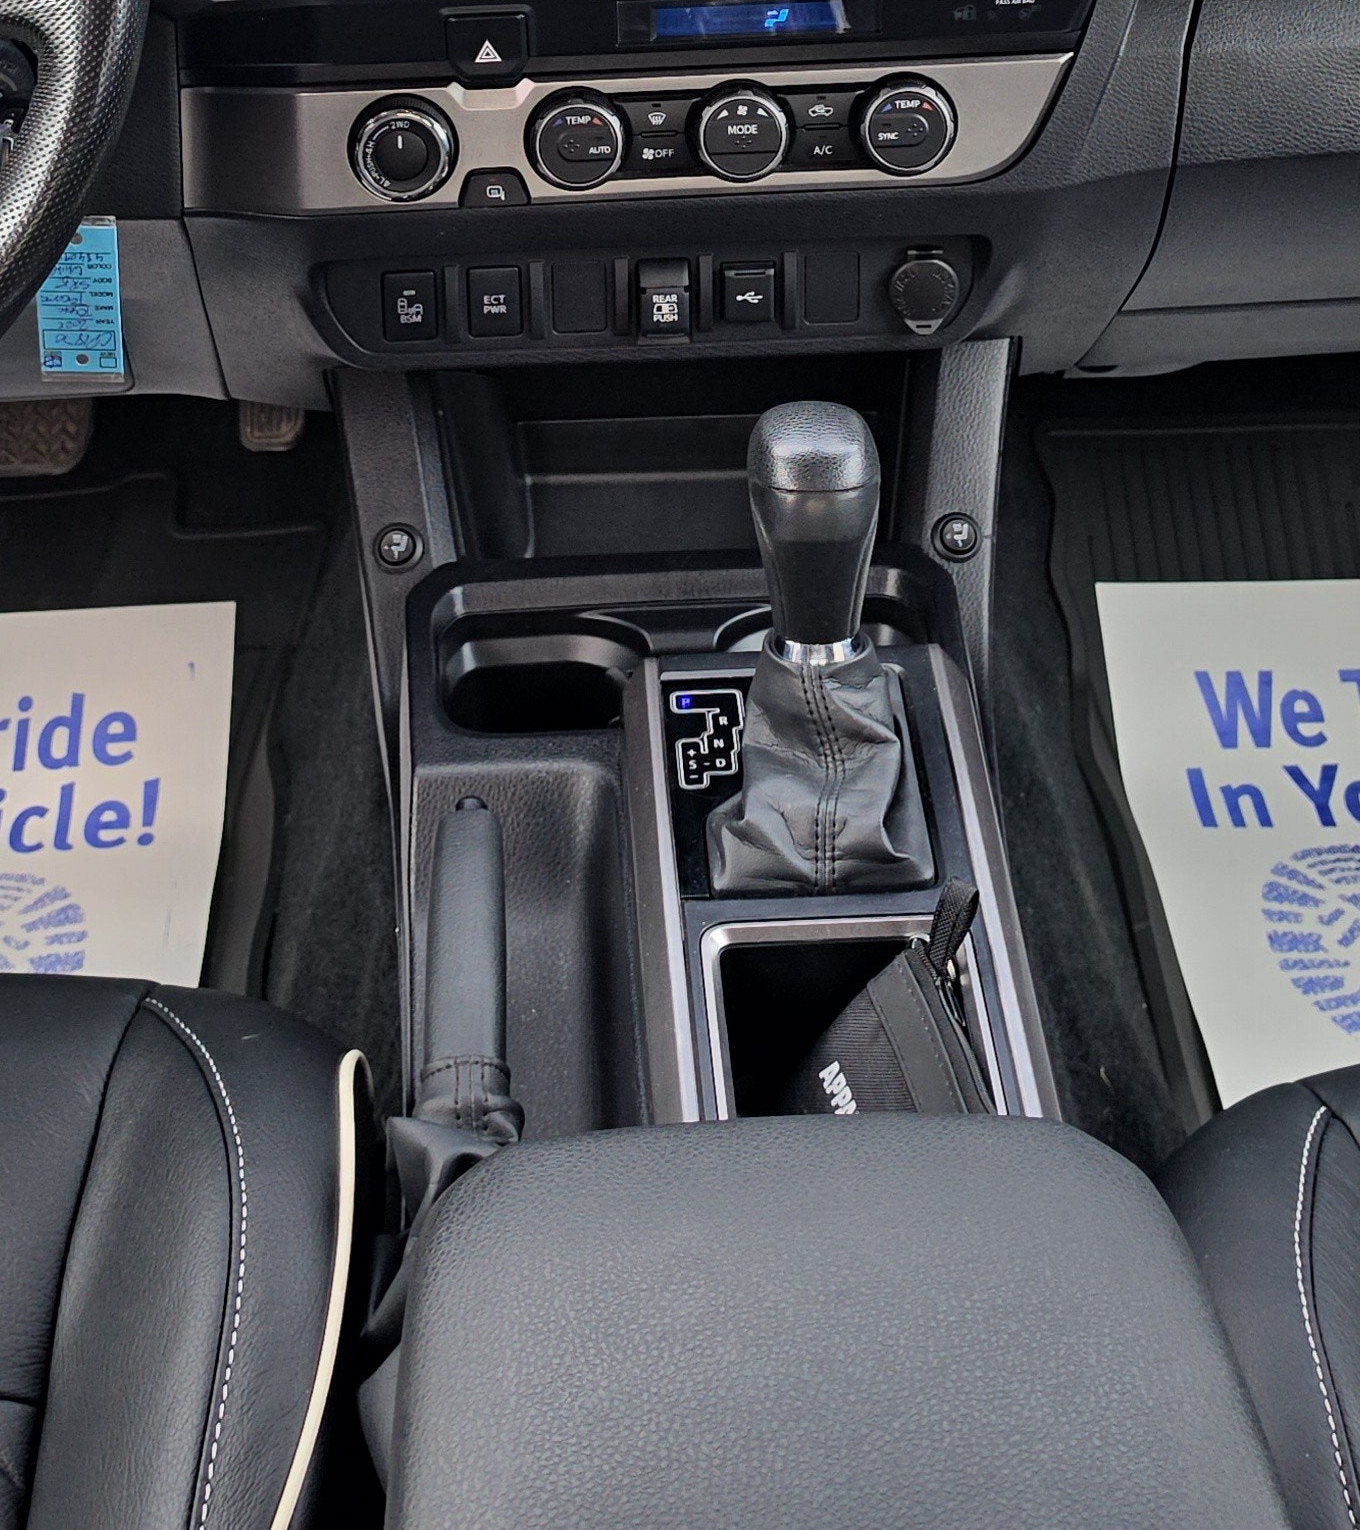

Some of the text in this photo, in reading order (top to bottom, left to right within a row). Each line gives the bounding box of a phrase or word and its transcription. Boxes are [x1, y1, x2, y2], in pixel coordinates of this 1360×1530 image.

[894, 99, 921, 110] TEMP
[389, 120, 410, 130] 2WD
[565, 115, 592, 126] TEMP
[727, 124, 759, 135] MODE
[878, 131, 899, 141] SYNC
[588, 145, 612, 155] AUTO
[655, 148, 675, 158] OFF
[813, 145, 833, 156] A/C
[483, 293, 507, 304] ECT
[653, 293, 678, 303] REAR
[483, 304, 508, 315] PWR
[400, 313, 422, 324] BSM
[653, 313, 679, 323] PUSH
[681, 697, 691, 708] P
[1194, 667, 1326, 751] We
[719, 716, 729, 726] R
[713, 738, 725, 749] N
[688, 760, 698, 770] S
[715, 758, 727, 768] D
[1186, 763, 1274, 831] In
